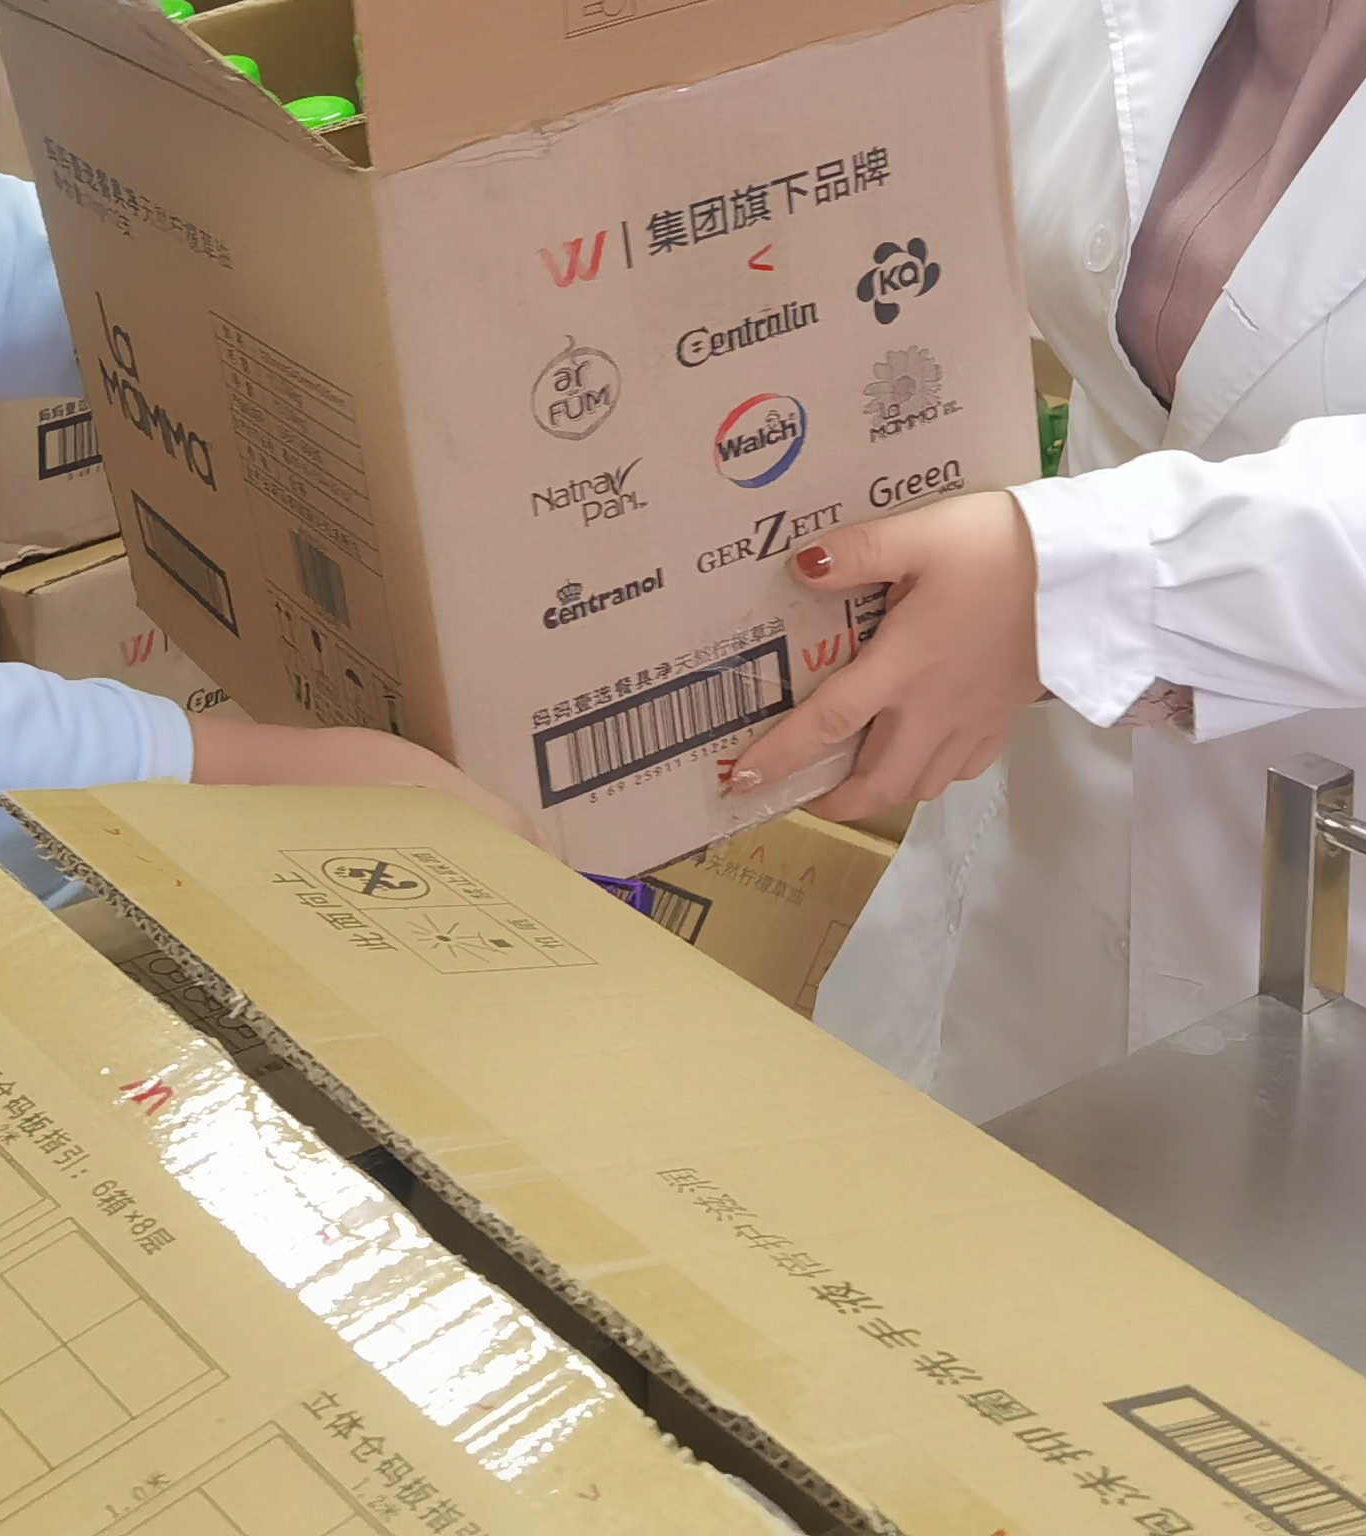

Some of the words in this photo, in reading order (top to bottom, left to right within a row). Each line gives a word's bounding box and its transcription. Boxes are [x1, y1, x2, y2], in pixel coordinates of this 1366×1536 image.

[645, 146, 892, 257] 集团旗下品牌
[716, 414, 799, 463] Walch
[870, 459, 962, 510] Green
[542, 568, 665, 632] Centranol
